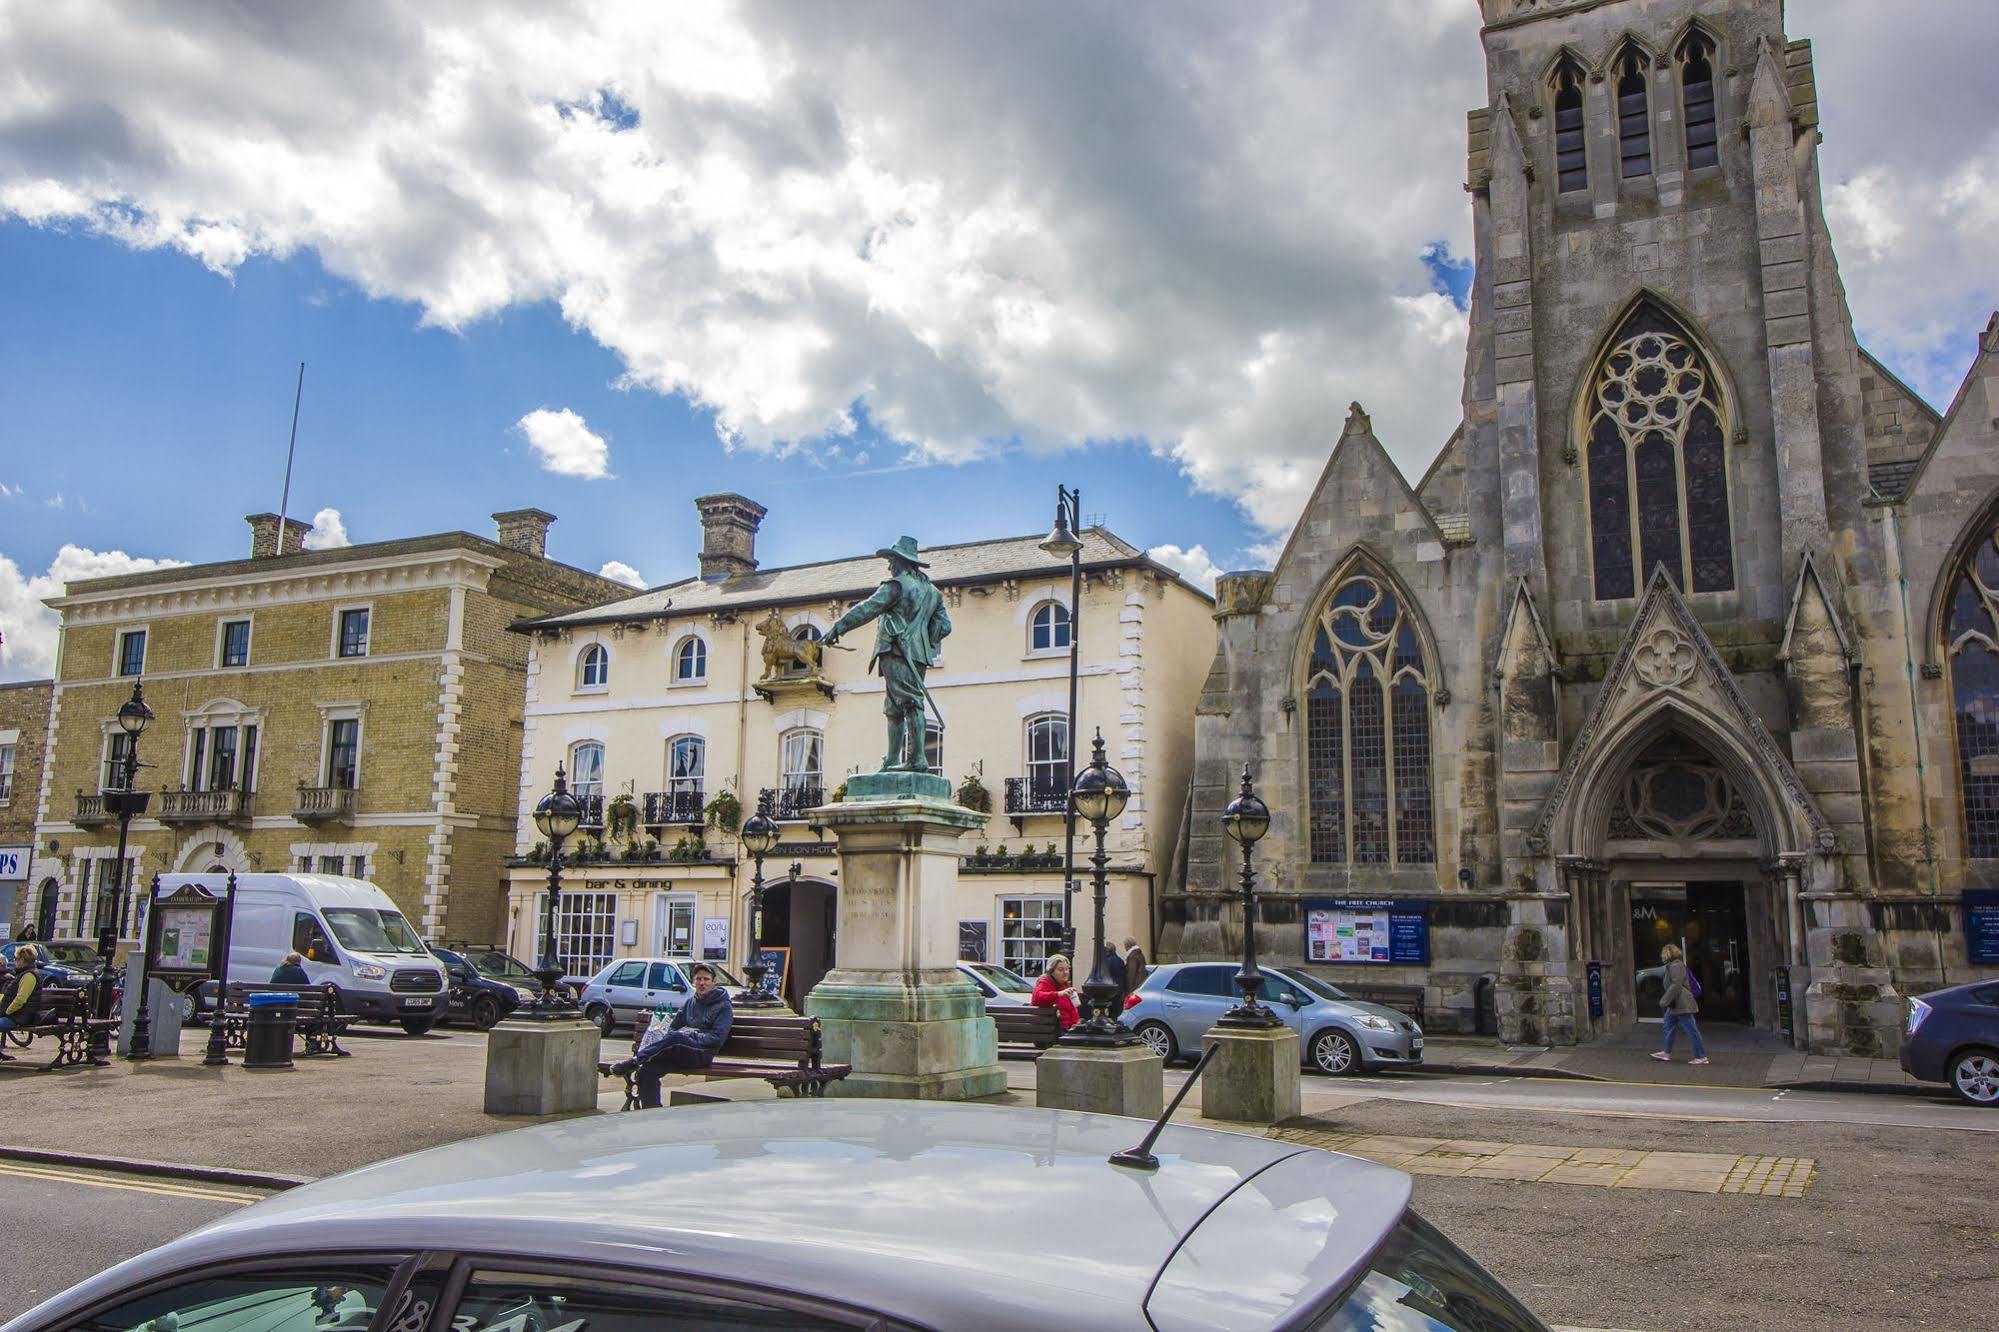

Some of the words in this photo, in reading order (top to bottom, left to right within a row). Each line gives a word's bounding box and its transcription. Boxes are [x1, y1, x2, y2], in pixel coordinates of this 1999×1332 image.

[789, 846, 811, 855] LION
[0, 853, 18, 874] PS
[585, 879, 610, 889] bar
[614, 879, 625, 889] &
[632, 879, 673, 891] dining
